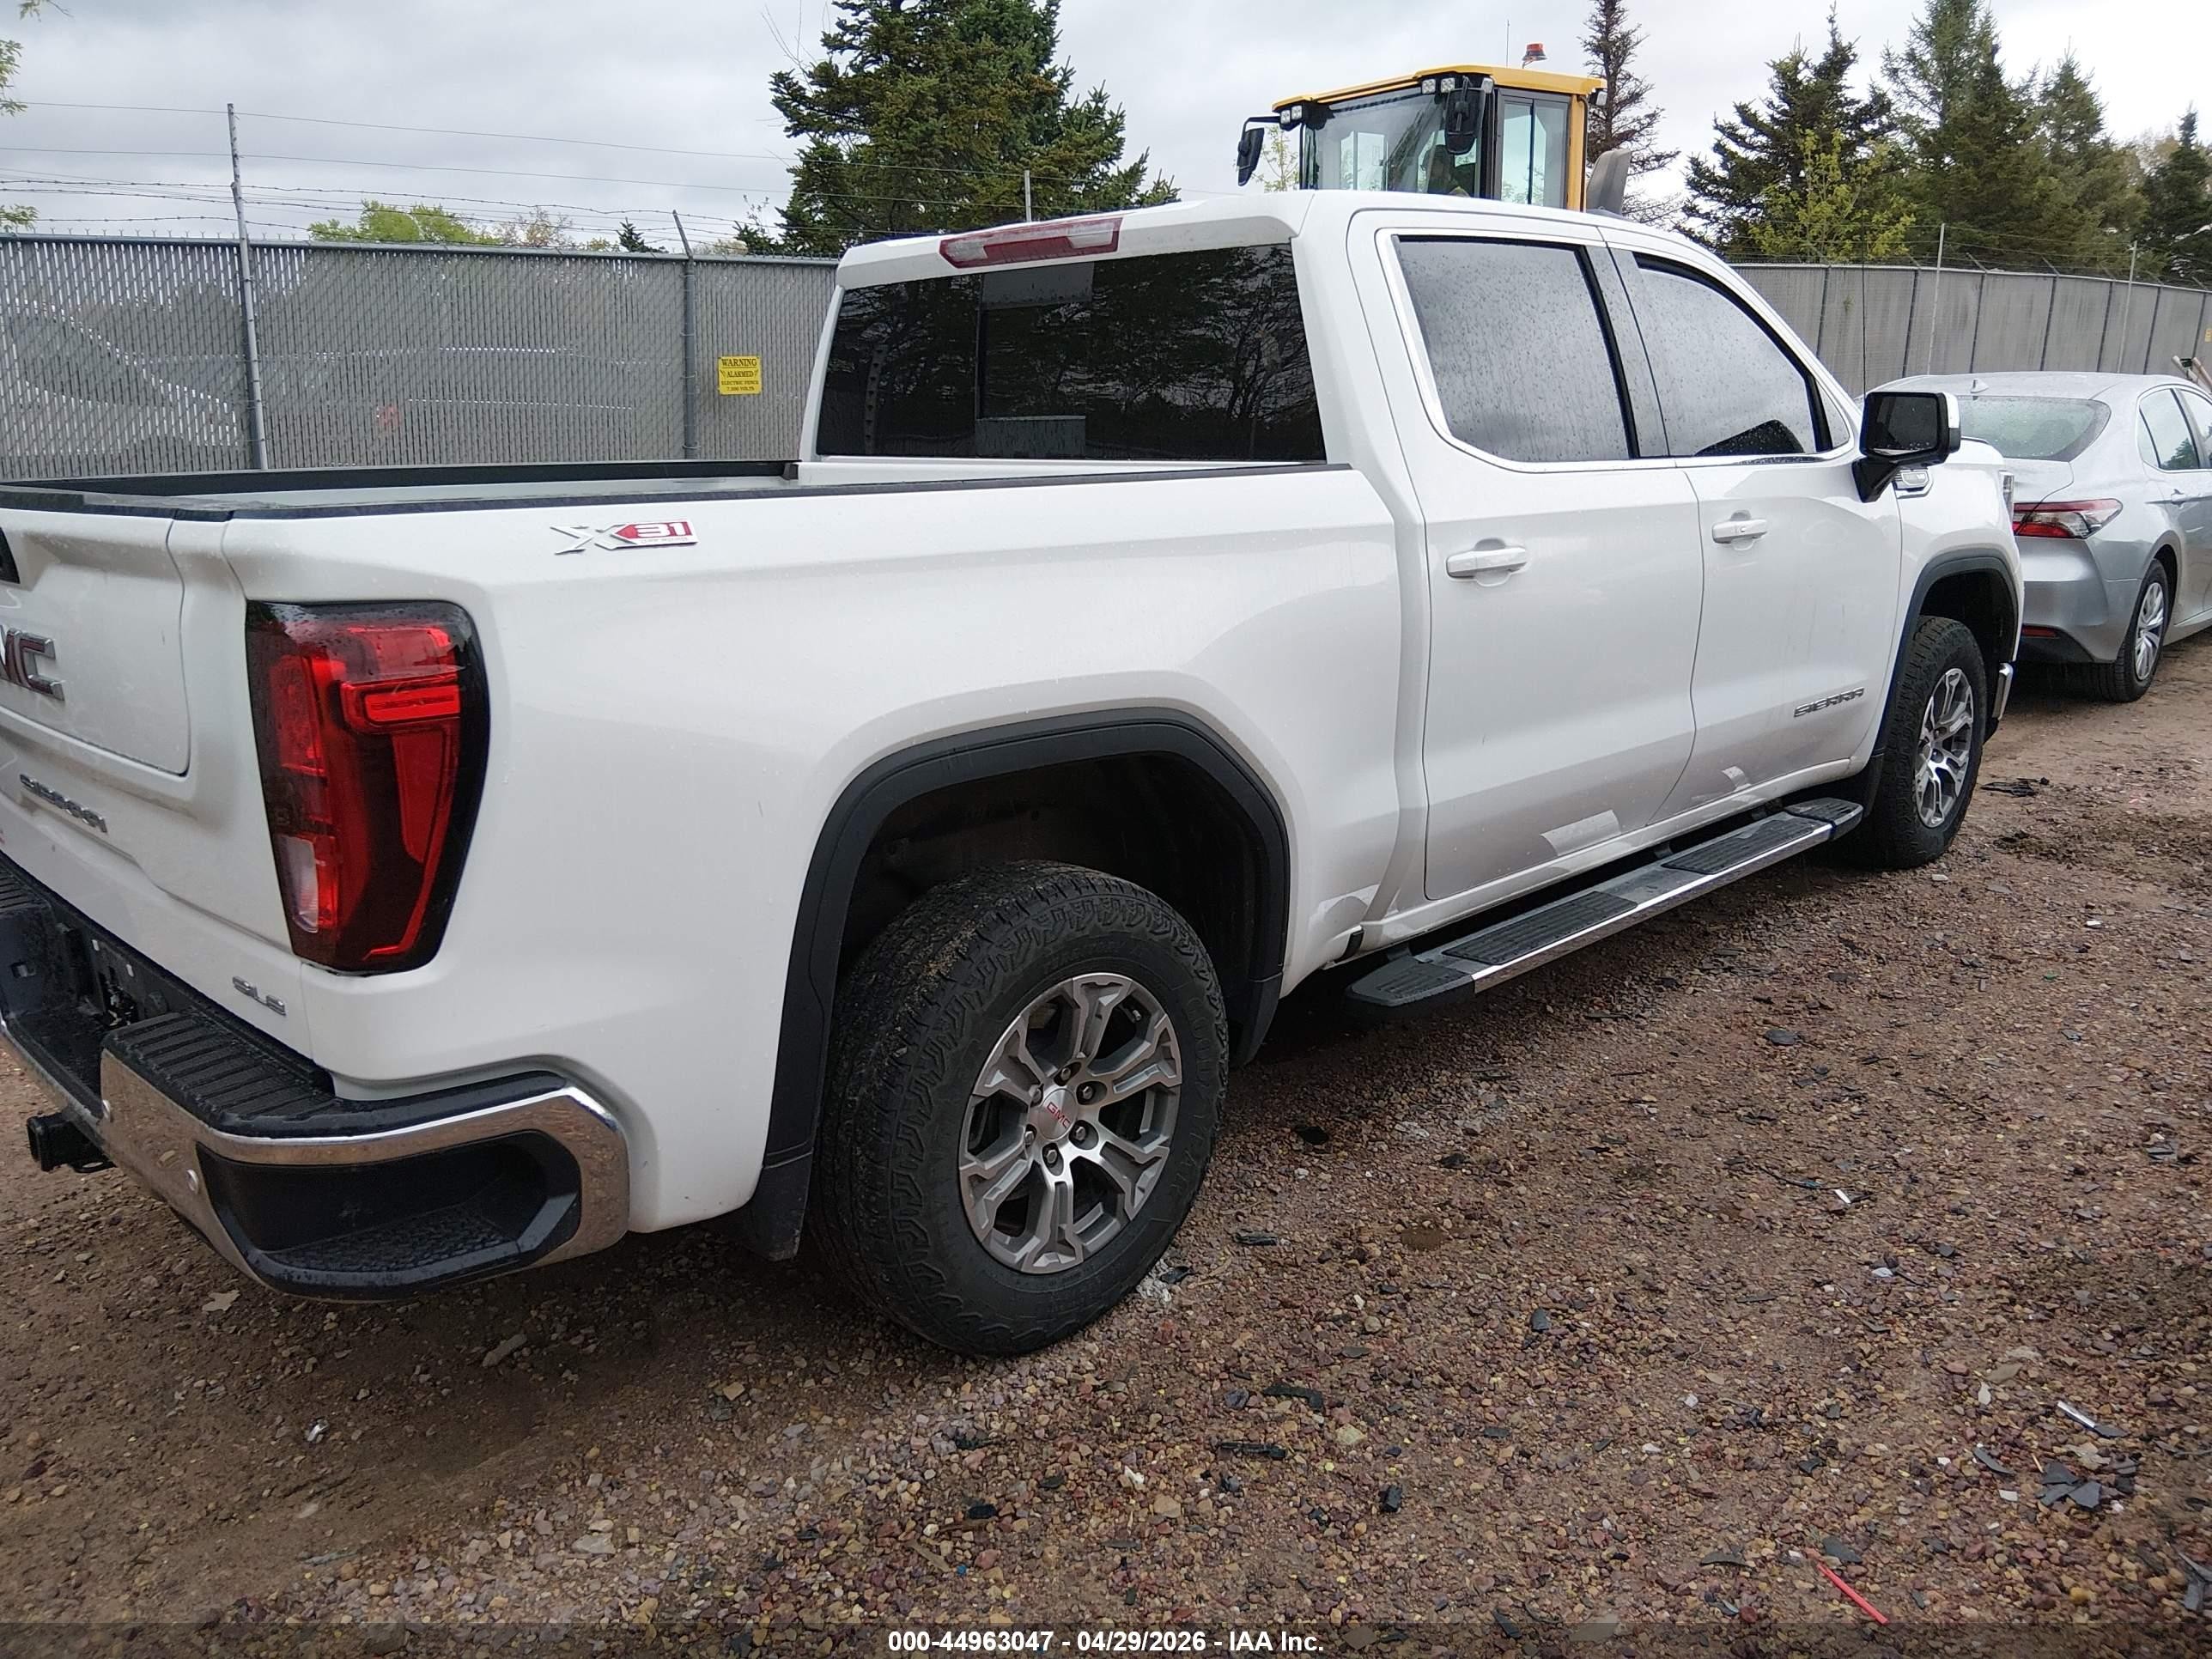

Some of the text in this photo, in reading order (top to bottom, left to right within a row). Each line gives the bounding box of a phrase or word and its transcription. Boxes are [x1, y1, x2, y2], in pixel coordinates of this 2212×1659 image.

[721, 358, 757, 367] WARNING
[1793, 687, 1865, 718] SIERRA
[1046, 1101, 1071, 1129] GMC
